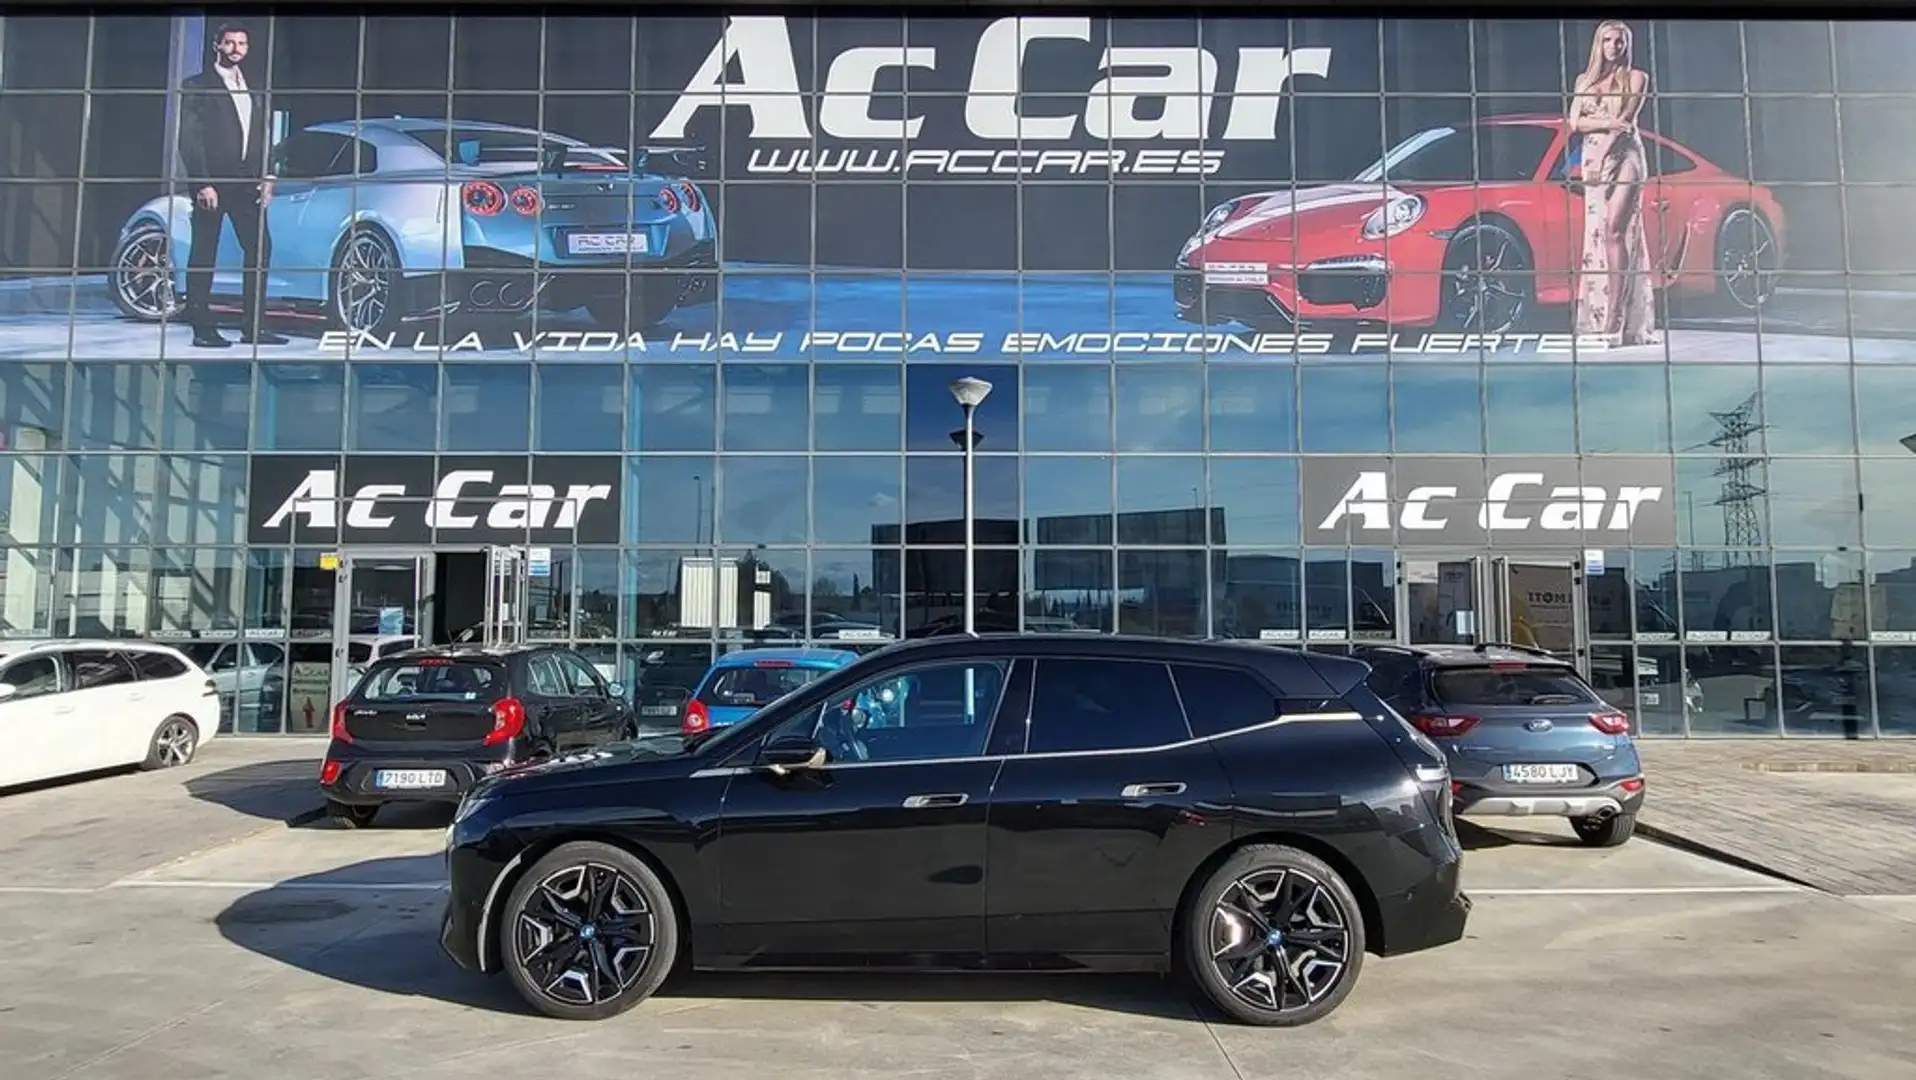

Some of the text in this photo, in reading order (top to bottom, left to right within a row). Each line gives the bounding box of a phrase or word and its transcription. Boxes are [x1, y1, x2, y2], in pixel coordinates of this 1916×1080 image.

[649, 16, 1332, 140] Ac Car
[317, 331, 1610, 353] EN LA VIDA HAY POCAS EMOCIONES FUERTES
[263, 470, 611, 528] Ac Car
[1318, 471, 1663, 530] Ac Car
[385, 771, 416, 784] 7190
[1513, 764, 1547, 778] 4580
